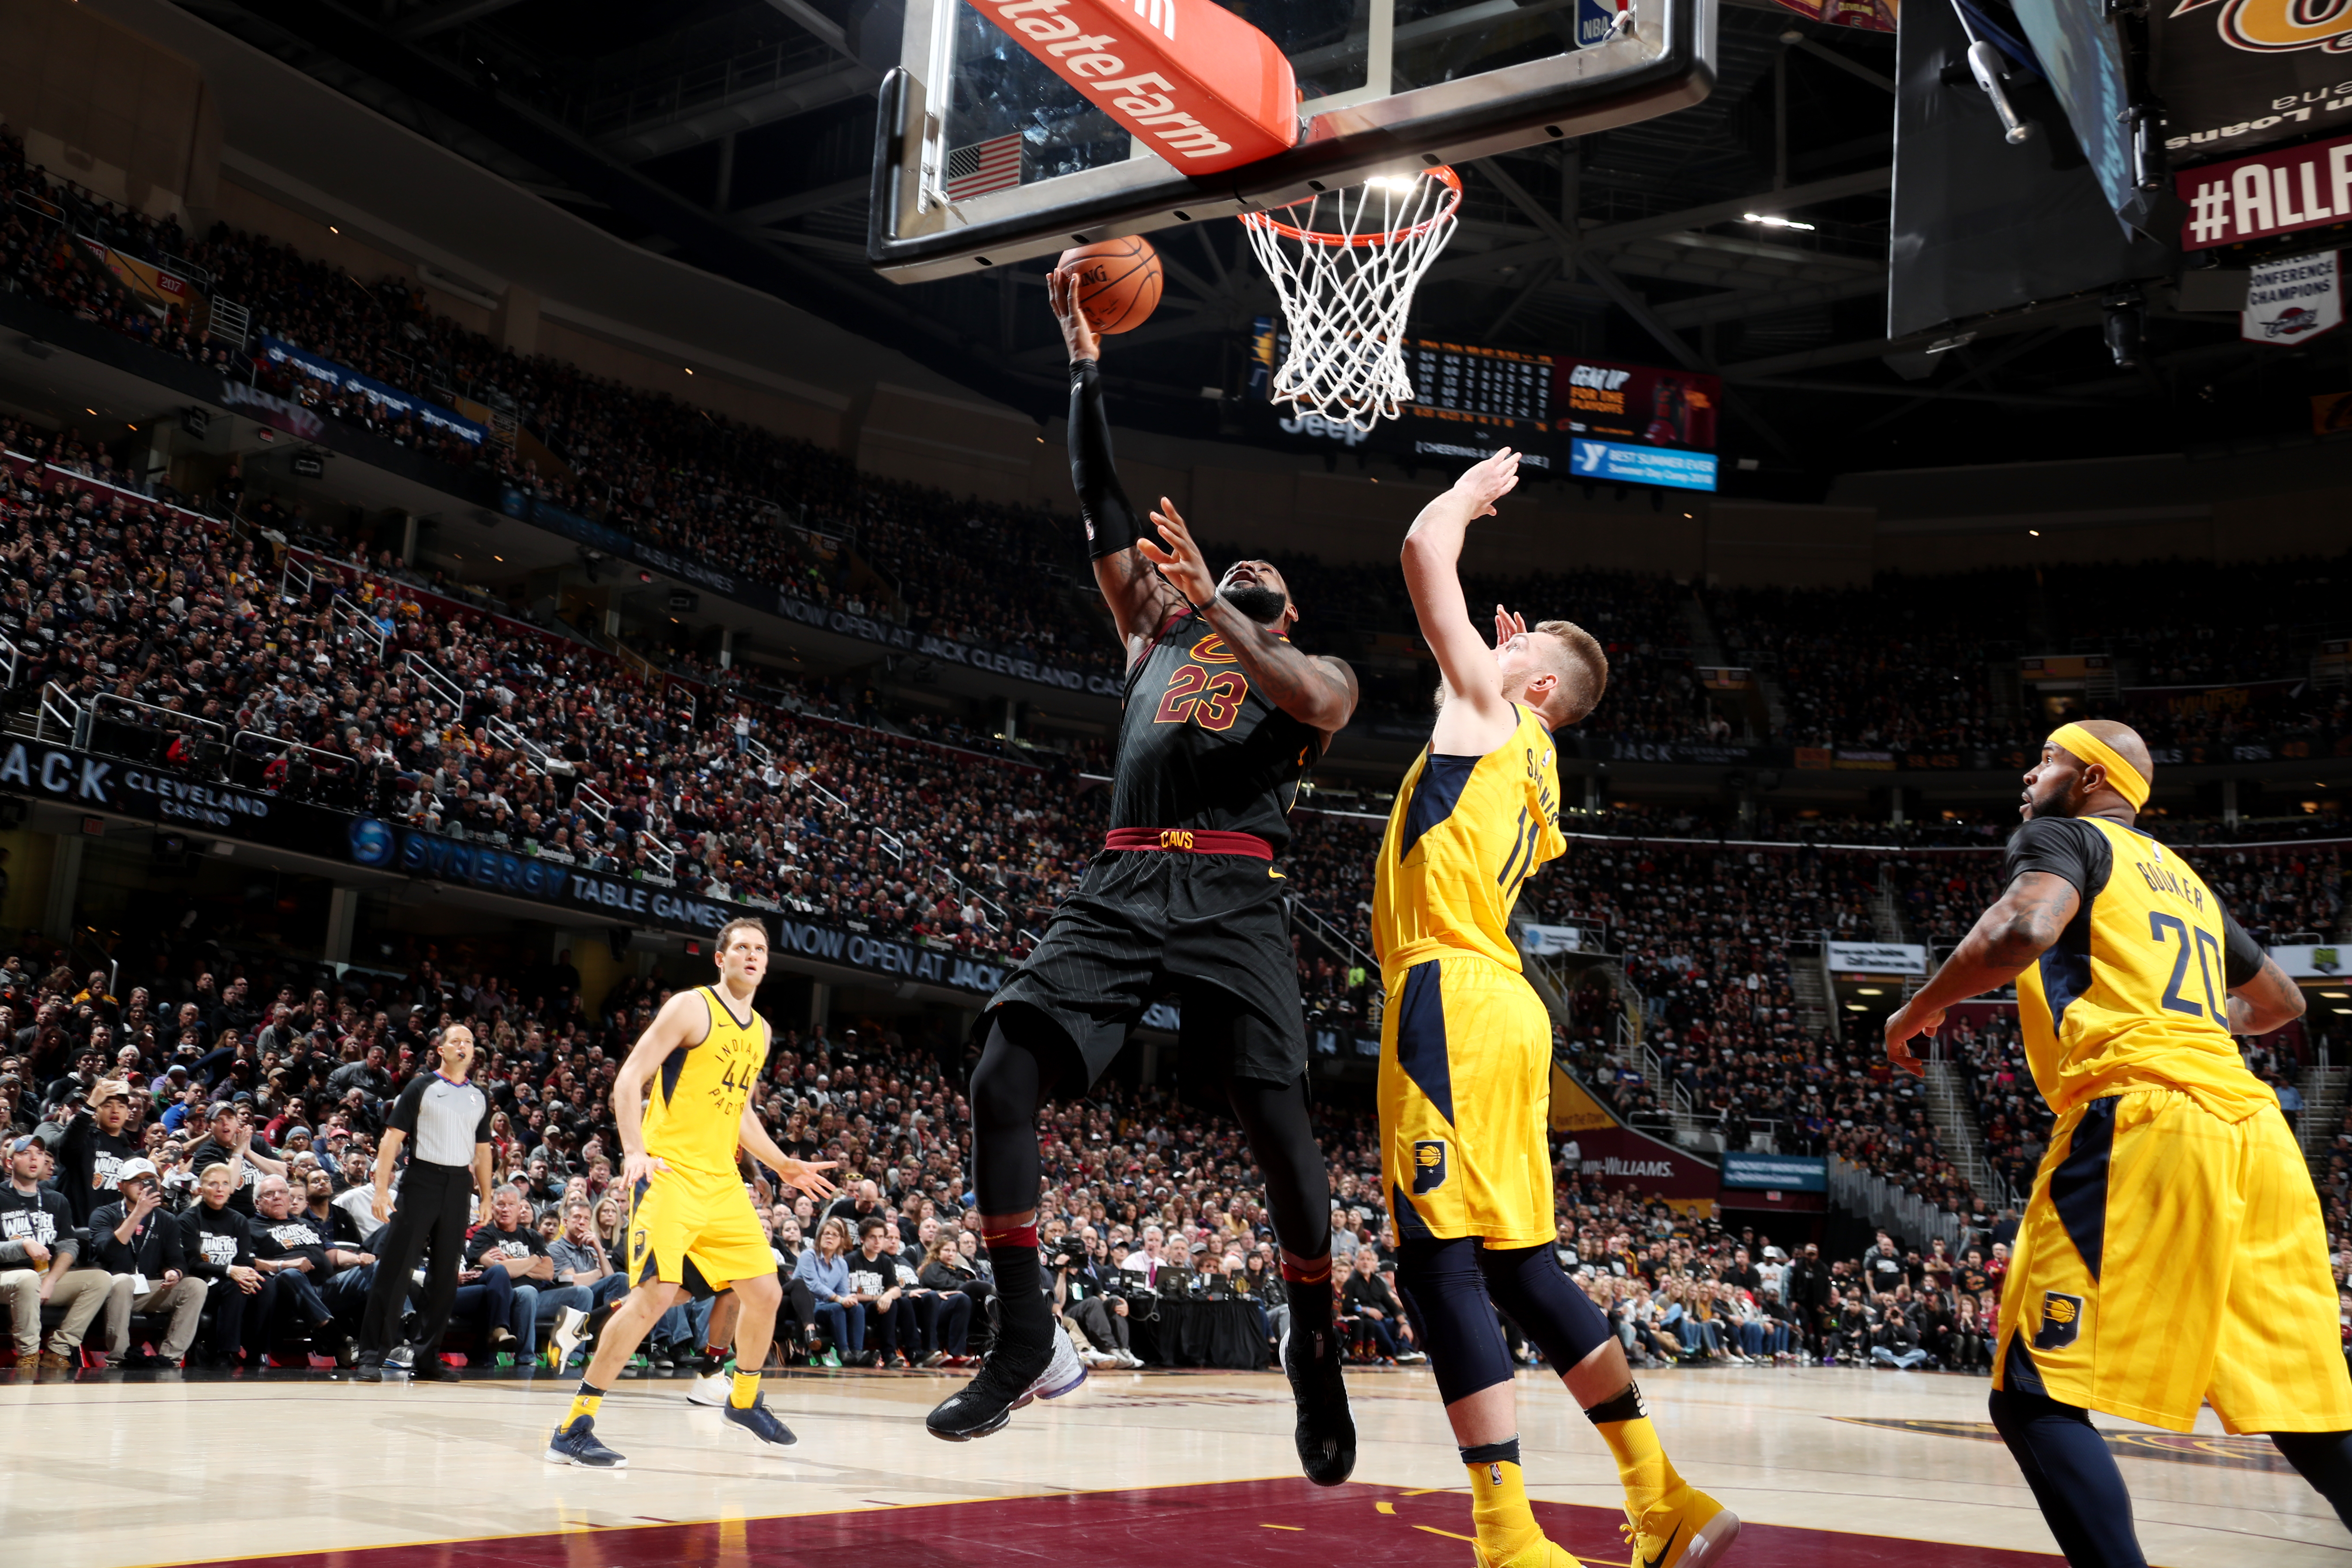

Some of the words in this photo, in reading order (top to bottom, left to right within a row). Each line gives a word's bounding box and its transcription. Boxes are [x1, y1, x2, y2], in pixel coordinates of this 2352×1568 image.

[994, 0, 1125, 77] tate
[1583, 15, 1609, 40] NBA
[160, 276, 183, 292] 207
[2250, 279, 2331, 305] CHAMPIONS
[778, 595, 828, 627] NOW
[830, 612, 889, 644] OPEN
[888, 625, 916, 649] AT
[918, 635, 968, 665] JACK
[969, 648, 1084, 690] CLEVELAND
[1084, 673, 1125, 698] CAS
[1154, 664, 1249, 731] 23
[1612, 741, 1674, 763] JACK
[124, 770, 269, 818] CLEVELAND
[159, 799, 231, 827] CASINO
[86, 819, 103, 836] EXIT
[1160, 831, 1194, 849] CAVS
[1497, 805, 1540, 900] 11
[2135, 861, 2204, 913] BOOKER
[570, 874, 648, 913] TABLE
[652, 893, 730, 930] GAMES
[781, 919, 845, 961] NOW
[848, 935, 914, 975] OPEN
[915, 950, 946, 982] AT
[948, 959, 1005, 993] JACK
[2149, 910, 2229, 1034] 20
[721, 1060, 751, 1097] 44
